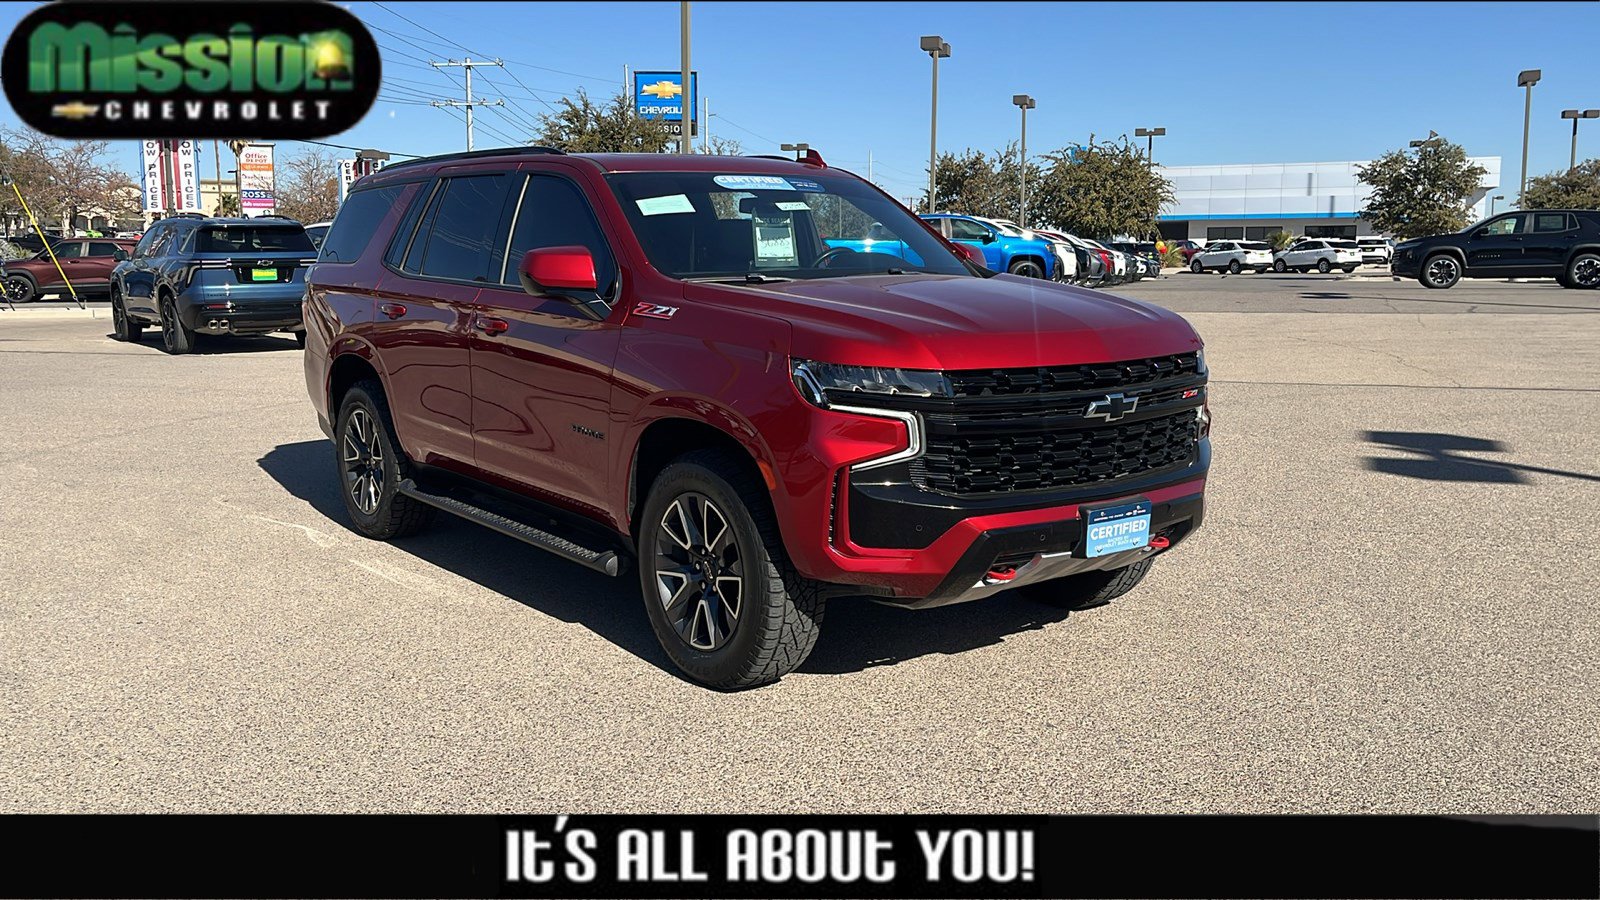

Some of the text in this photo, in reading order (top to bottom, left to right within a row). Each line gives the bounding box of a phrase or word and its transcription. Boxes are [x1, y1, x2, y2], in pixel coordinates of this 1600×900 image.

[640, 106, 682, 114] CHEVROL
[146, 141, 158, 209] OW PRICES
[181, 140, 194, 209] OW PRICES
[720, 175, 784, 184] CERTIFIED
[633, 301, 680, 319] Z71
[1090, 519, 1147, 540] CERTIFIED
